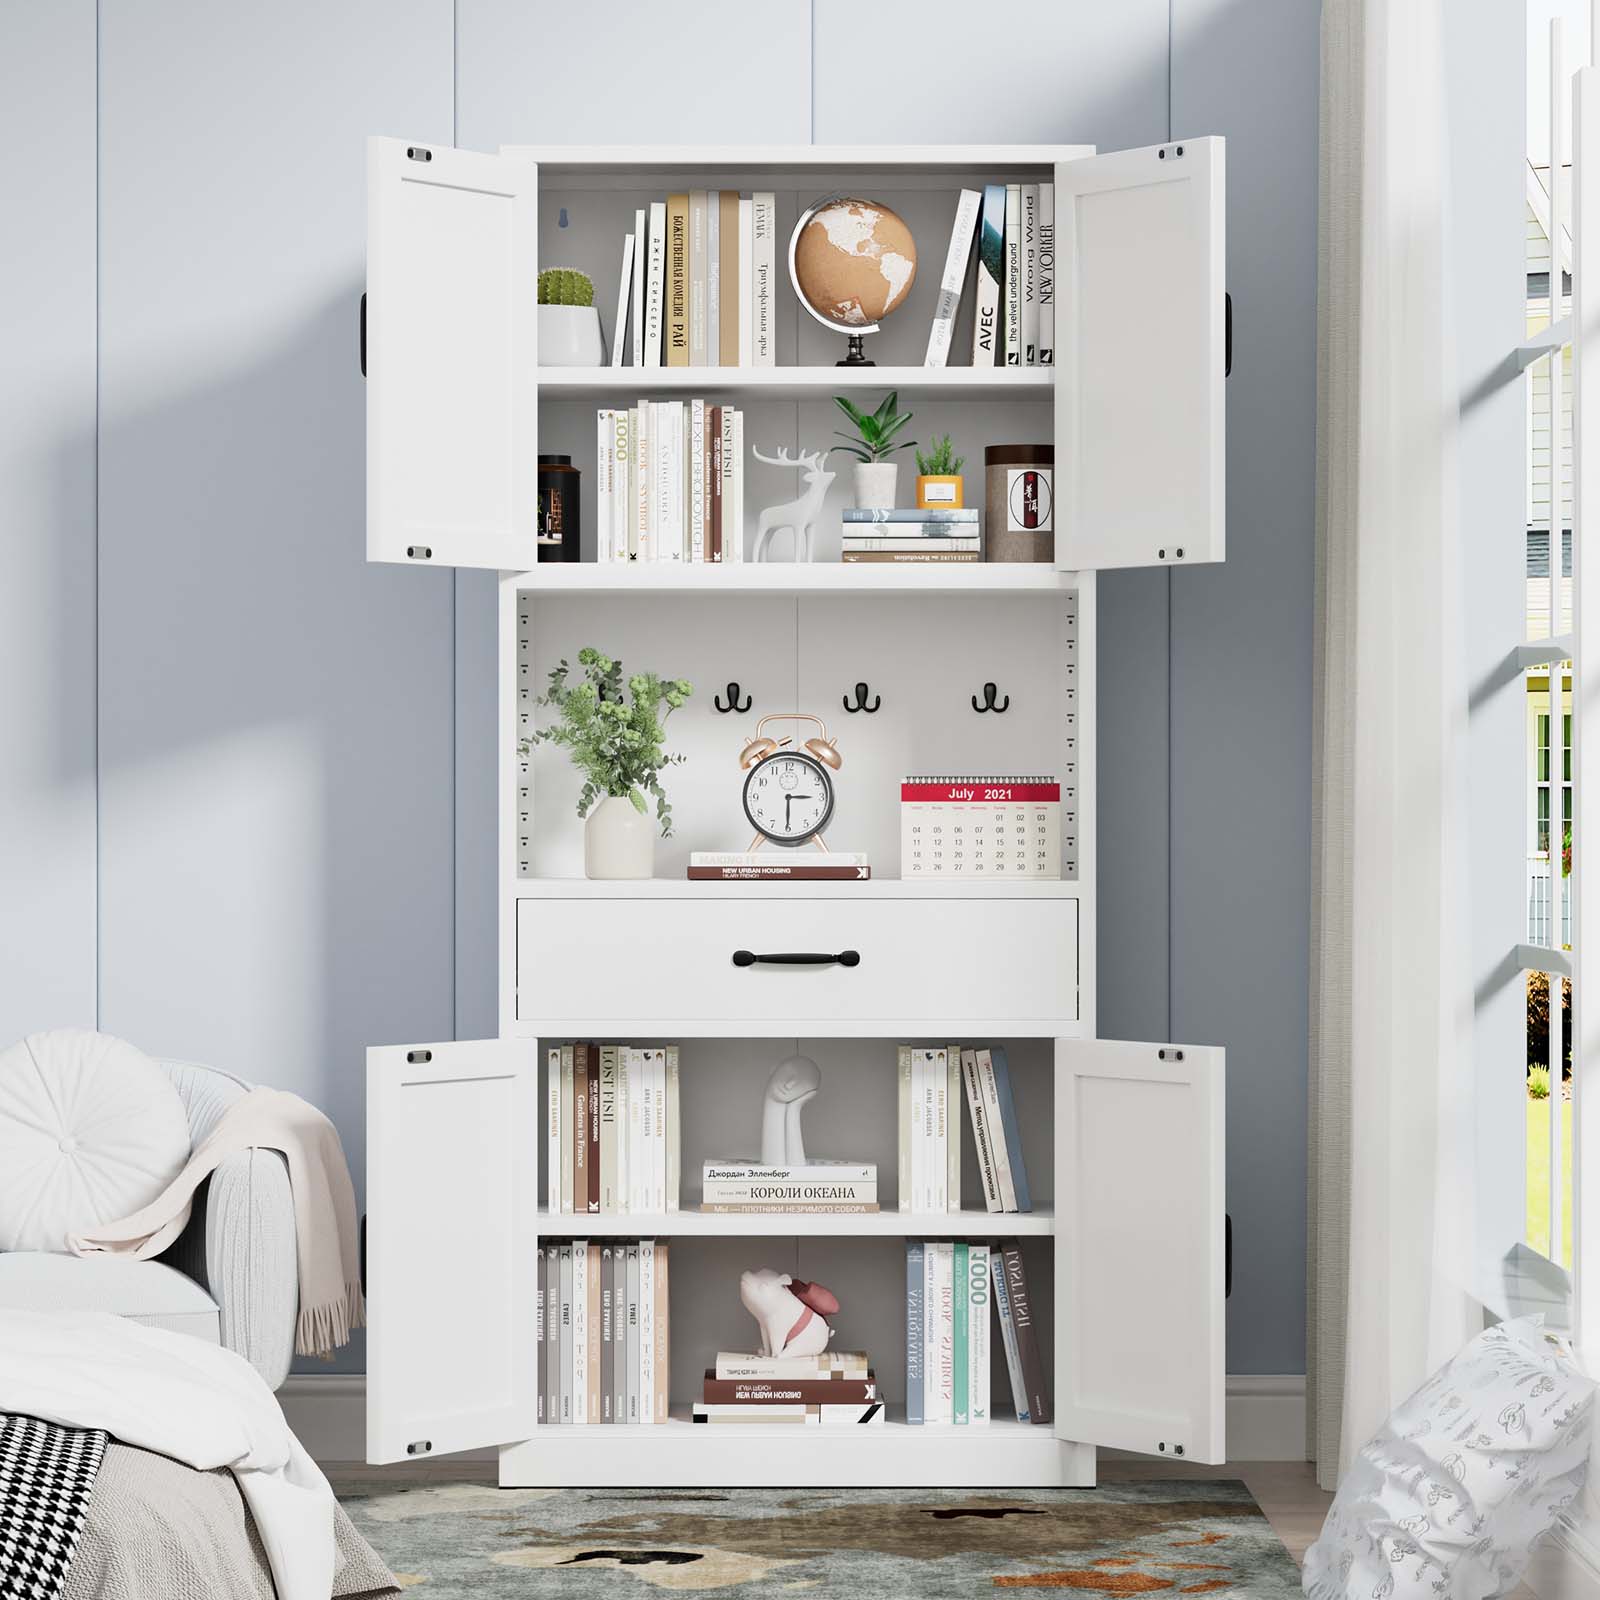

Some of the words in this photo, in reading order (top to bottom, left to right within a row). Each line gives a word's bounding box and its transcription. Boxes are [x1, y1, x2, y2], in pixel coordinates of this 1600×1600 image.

[673, 215, 684, 278] БОЖЕСТВЕННАЯ
[1040, 225, 1053, 275] YORKER
[1009, 243, 1019, 298] underground
[1026, 249, 1035, 303] Wrong
[673, 279, 684, 318] КОМЕДИЯ
[757, 263, 769, 332] Триумфальная
[1040, 277, 1053, 304] NEW
[650, 281, 659, 338] СИНСЕРО
[1009, 300, 1017, 326] velvet
[673, 324, 687, 348] РАЙ
[979, 307, 993, 351] AVEC
[1009, 327, 1017, 342] the
[757, 335, 769, 357] арка
[616, 416, 627, 461] 1000
[693, 403, 702, 458] ALEXEY
[724, 411, 732, 444] LOST
[640, 439, 648, 471] BOOK
[724, 448, 732, 478] FISH
[640, 483, 648, 541] SYMBOLS
[693, 462, 702, 553] BRODOVITCH
[771, 766, 778, 775] 11
[785, 762, 794, 771] 12
[803, 766, 807, 774] 1
[759, 777, 767, 787] 10
[814, 777, 820, 786] 2
[948, 788, 974, 800] July
[984, 789, 1012, 800] 2021
[753, 792, 759, 801] 9
[819, 793, 824, 801] 3
[757, 809, 763, 817] 8
[770, 820, 775, 828] 7
[803, 820, 809, 828] 5
[813, 808, 819, 817] 4
[913, 826, 921, 834] 04
[933, 826, 942, 834] 05
[954, 826, 962, 834] 06
[975, 826, 983, 834] 07
[996, 826, 1004, 834] 08
[1016, 826, 1025, 834] 09
[1037, 826, 1046, 834] 10
[913, 863, 921, 871] 25
[933, 863, 942, 871] 26
[954, 863, 962, 871] 27
[975, 863, 983, 871] 28
[996, 863, 1004, 871] 29
[1016, 863, 1025, 871] 30
[1037, 863, 1046, 871] 31
[603, 1051, 614, 1087] LOST
[577, 1094, 585, 1129] Gardens
[603, 1091, 614, 1122] FISH
[975, 1106, 984, 1127] Метод
[577, 1130, 585, 1139] in
[977, 1127, 990, 1166] управления
[577, 1140, 585, 1168] France
[708, 1170, 745, 1178] Джордан
[747, 1169, 790, 1178] Элленберг
[983, 1166, 996, 1200] проектами
[750, 1187, 801, 1199] КОРОЛИ
[804, 1187, 856, 1199] ОКЕАНА
[835, 1205, 867, 1213] СОБОРА
